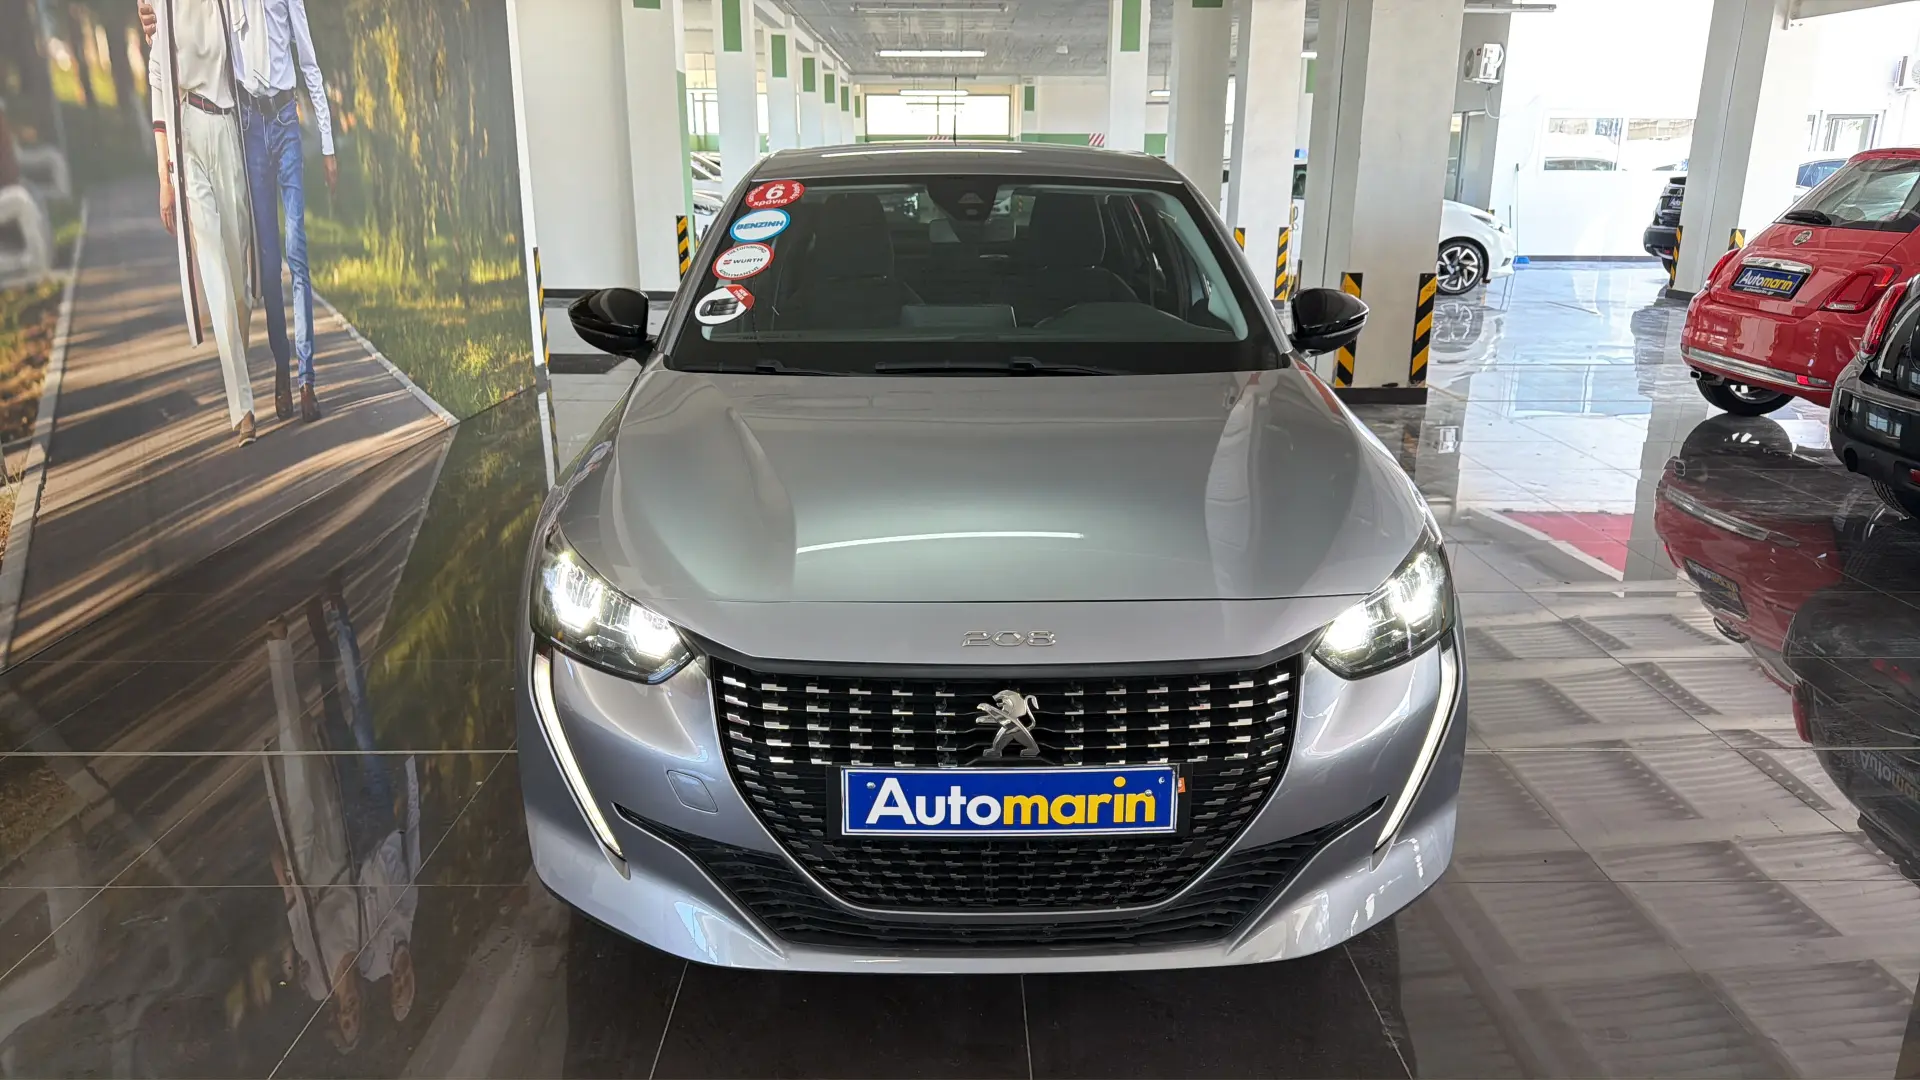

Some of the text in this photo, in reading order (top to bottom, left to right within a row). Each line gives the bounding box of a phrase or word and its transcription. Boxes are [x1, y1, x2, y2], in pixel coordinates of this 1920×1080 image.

[765, 186, 784, 200] 6
[1739, 269, 1793, 291] Automarin
[961, 629, 1057, 647] 208
[865, 776, 1156, 826] Automarin
